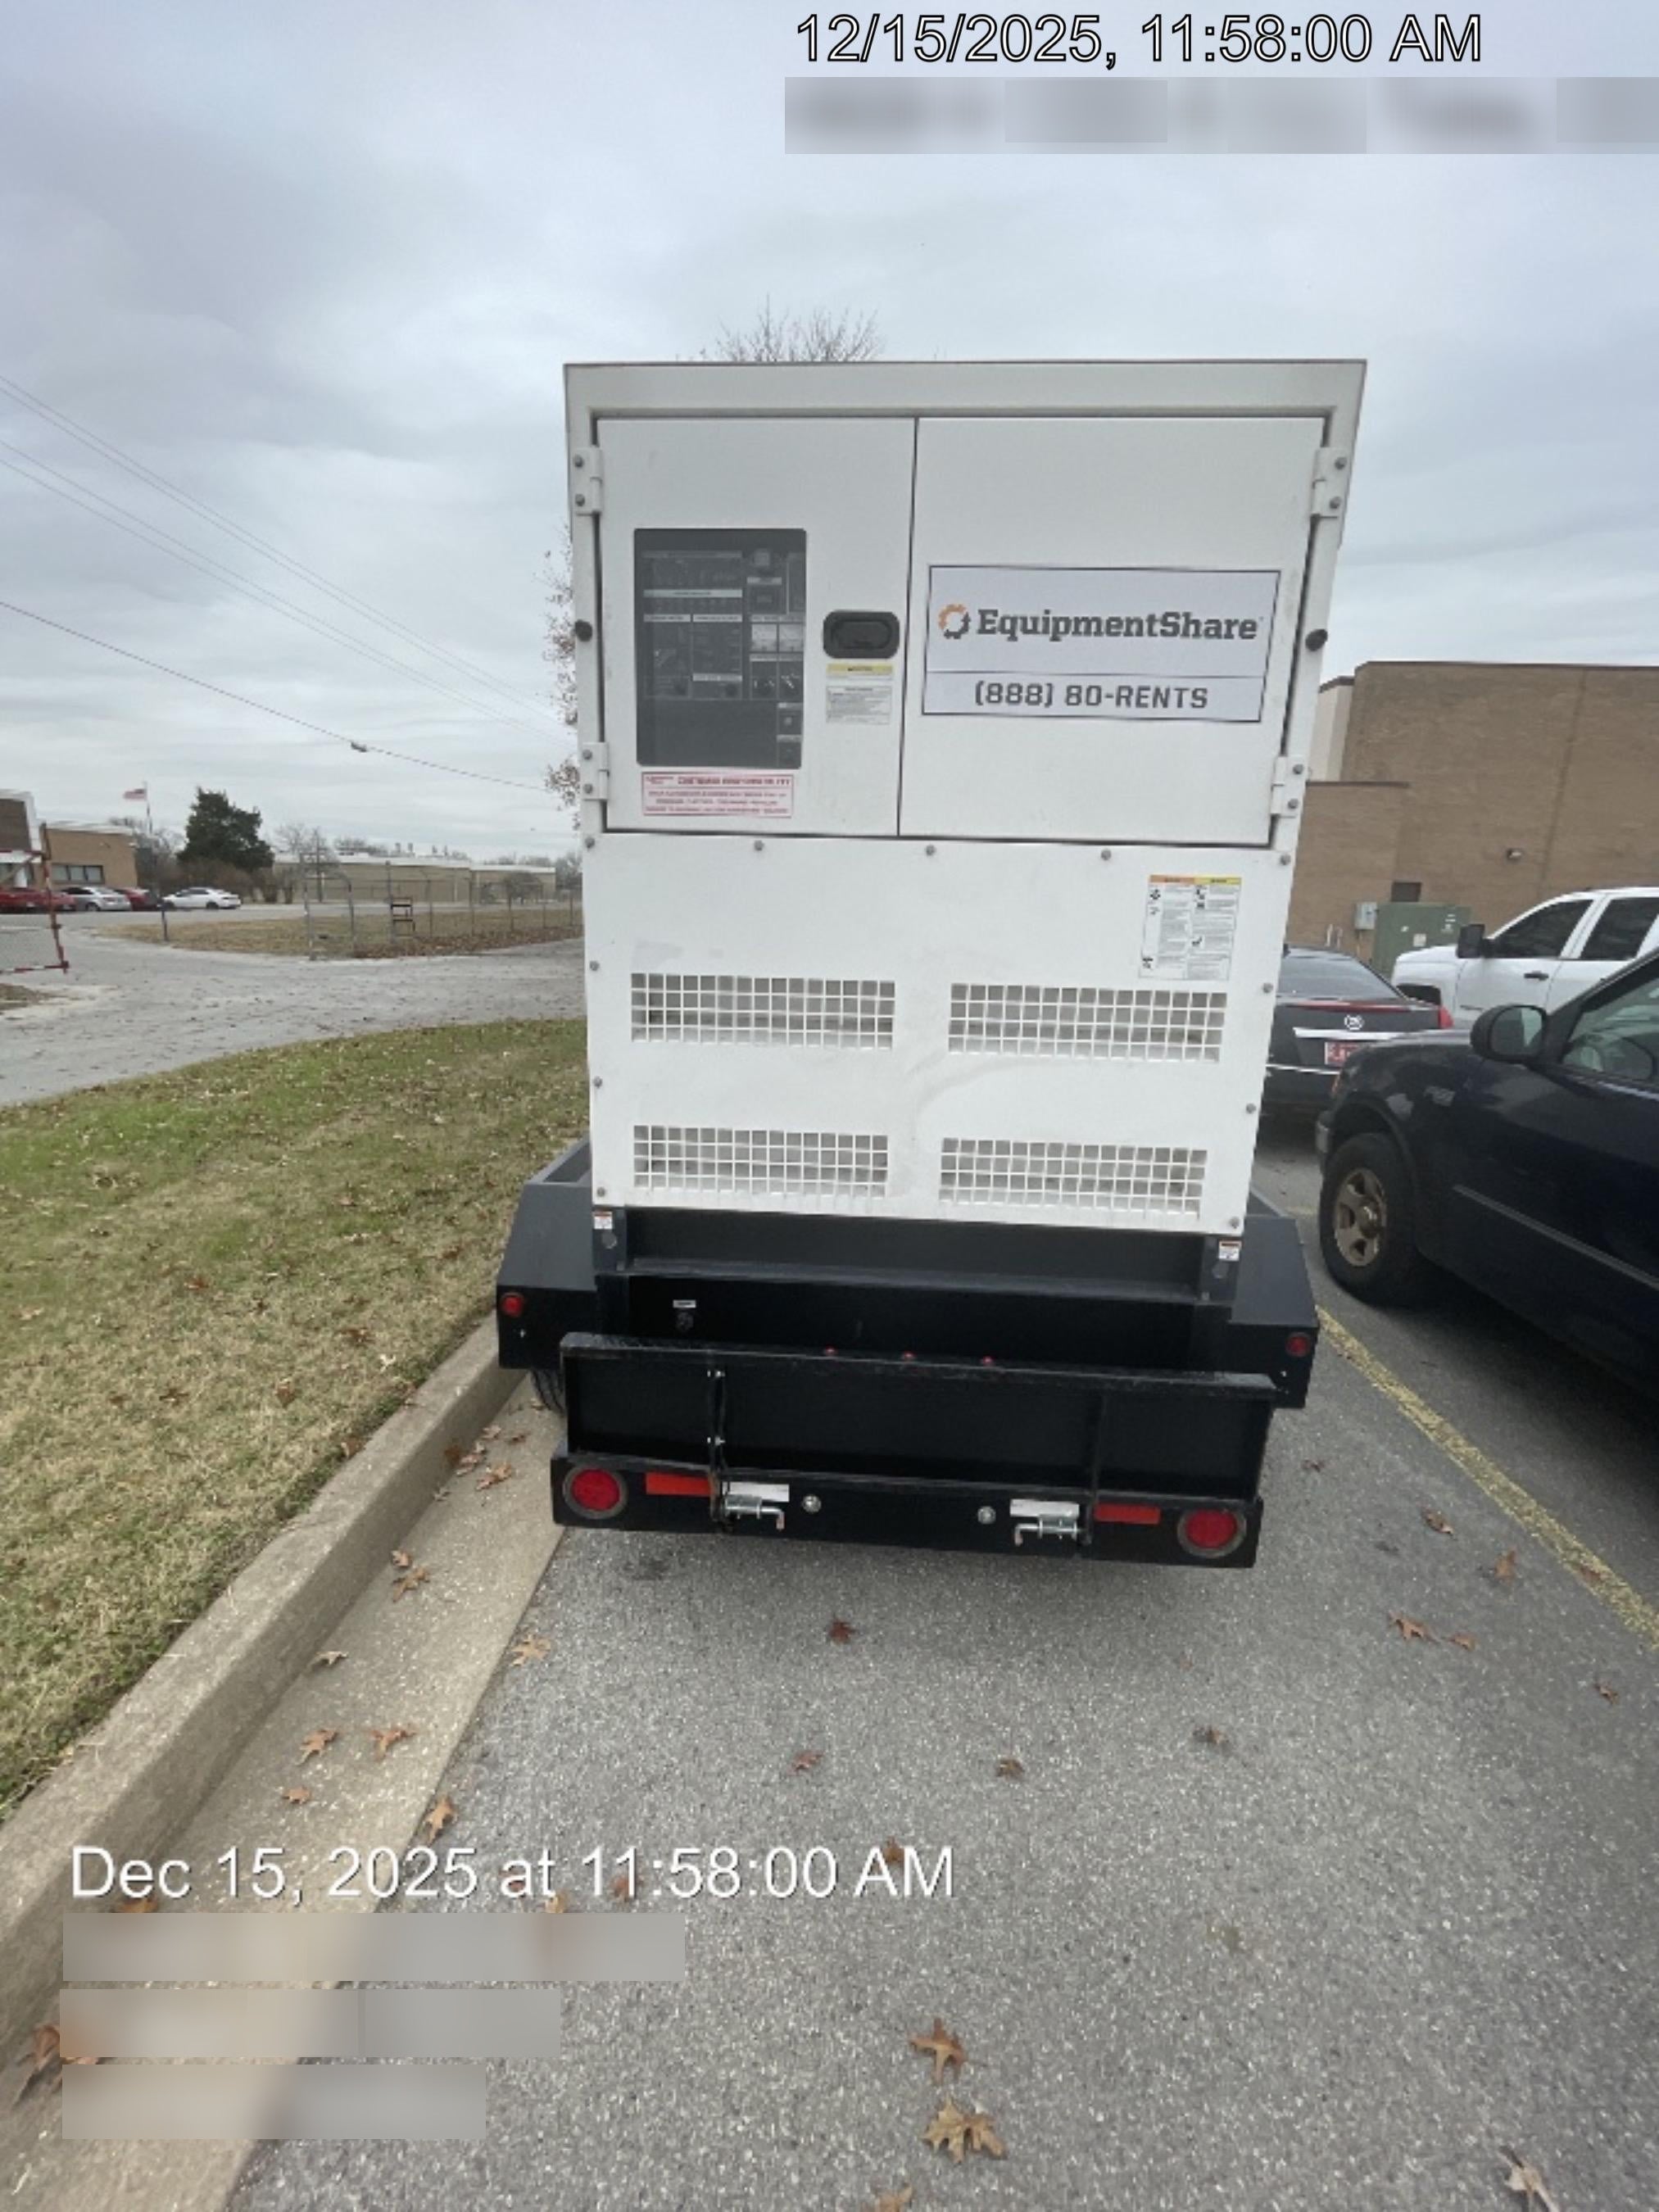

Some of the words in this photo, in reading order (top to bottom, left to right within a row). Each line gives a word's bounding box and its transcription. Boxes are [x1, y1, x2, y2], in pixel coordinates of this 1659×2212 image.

[977, 609, 1257, 641] EquipmentShare
[975, 680, 1054, 707] (888)
[1065, 685, 1208, 709] 80-RENTS
